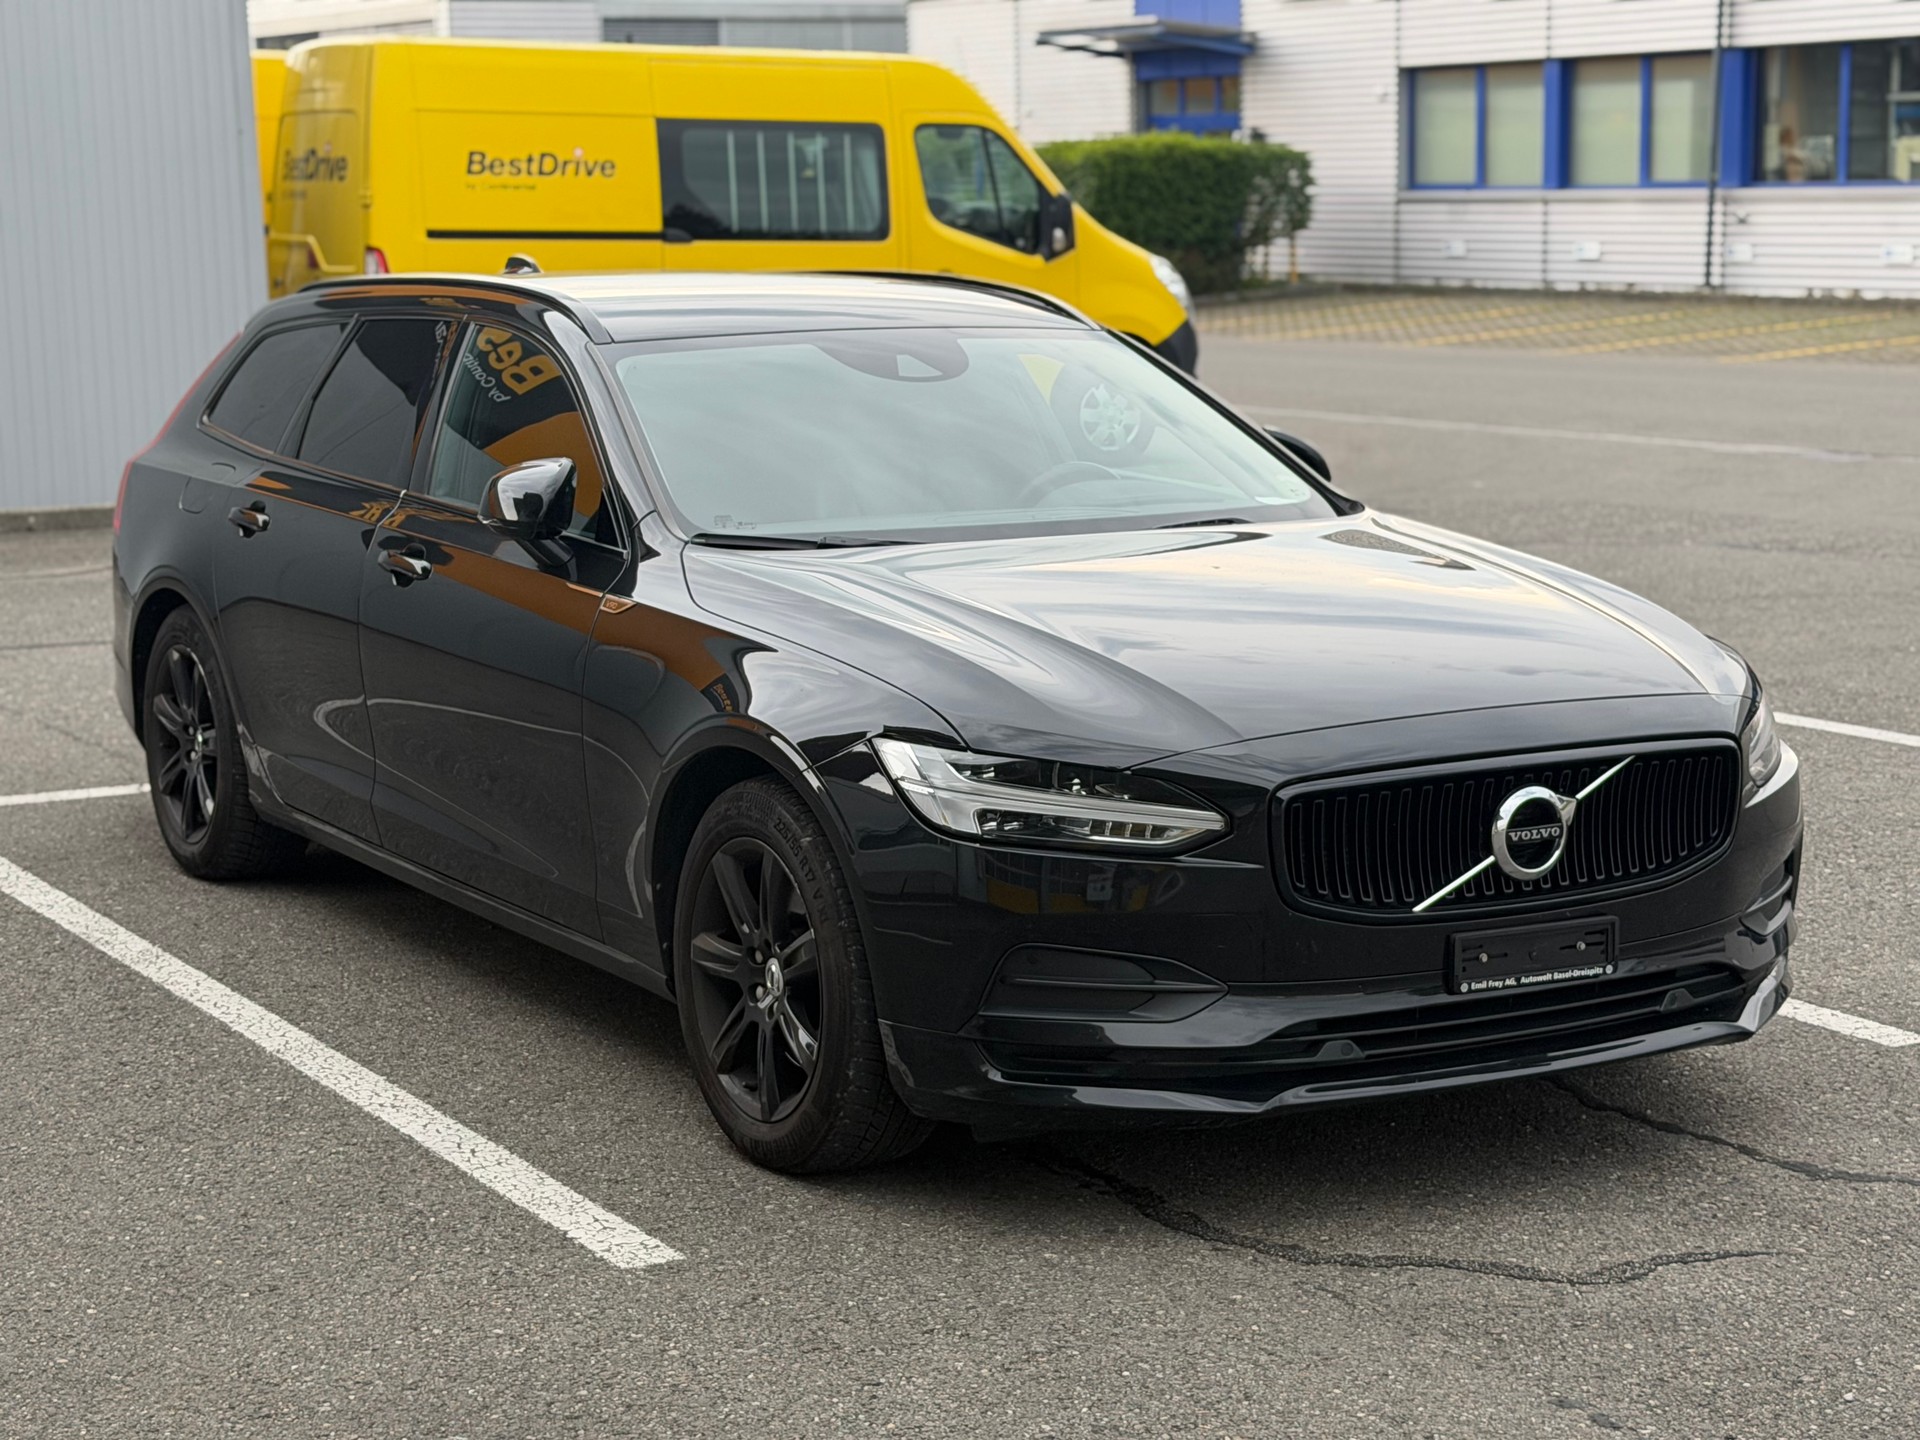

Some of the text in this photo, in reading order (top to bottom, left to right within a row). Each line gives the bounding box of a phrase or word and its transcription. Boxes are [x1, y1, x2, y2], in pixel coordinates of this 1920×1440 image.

[467, 147, 616, 178] BestDrive
[1509, 826, 1560, 842] VOLVO
[1471, 980, 1487, 990] Emil
[1488, 979, 1503, 989] Frey
[1520, 972, 1552, 984] Autowelt
